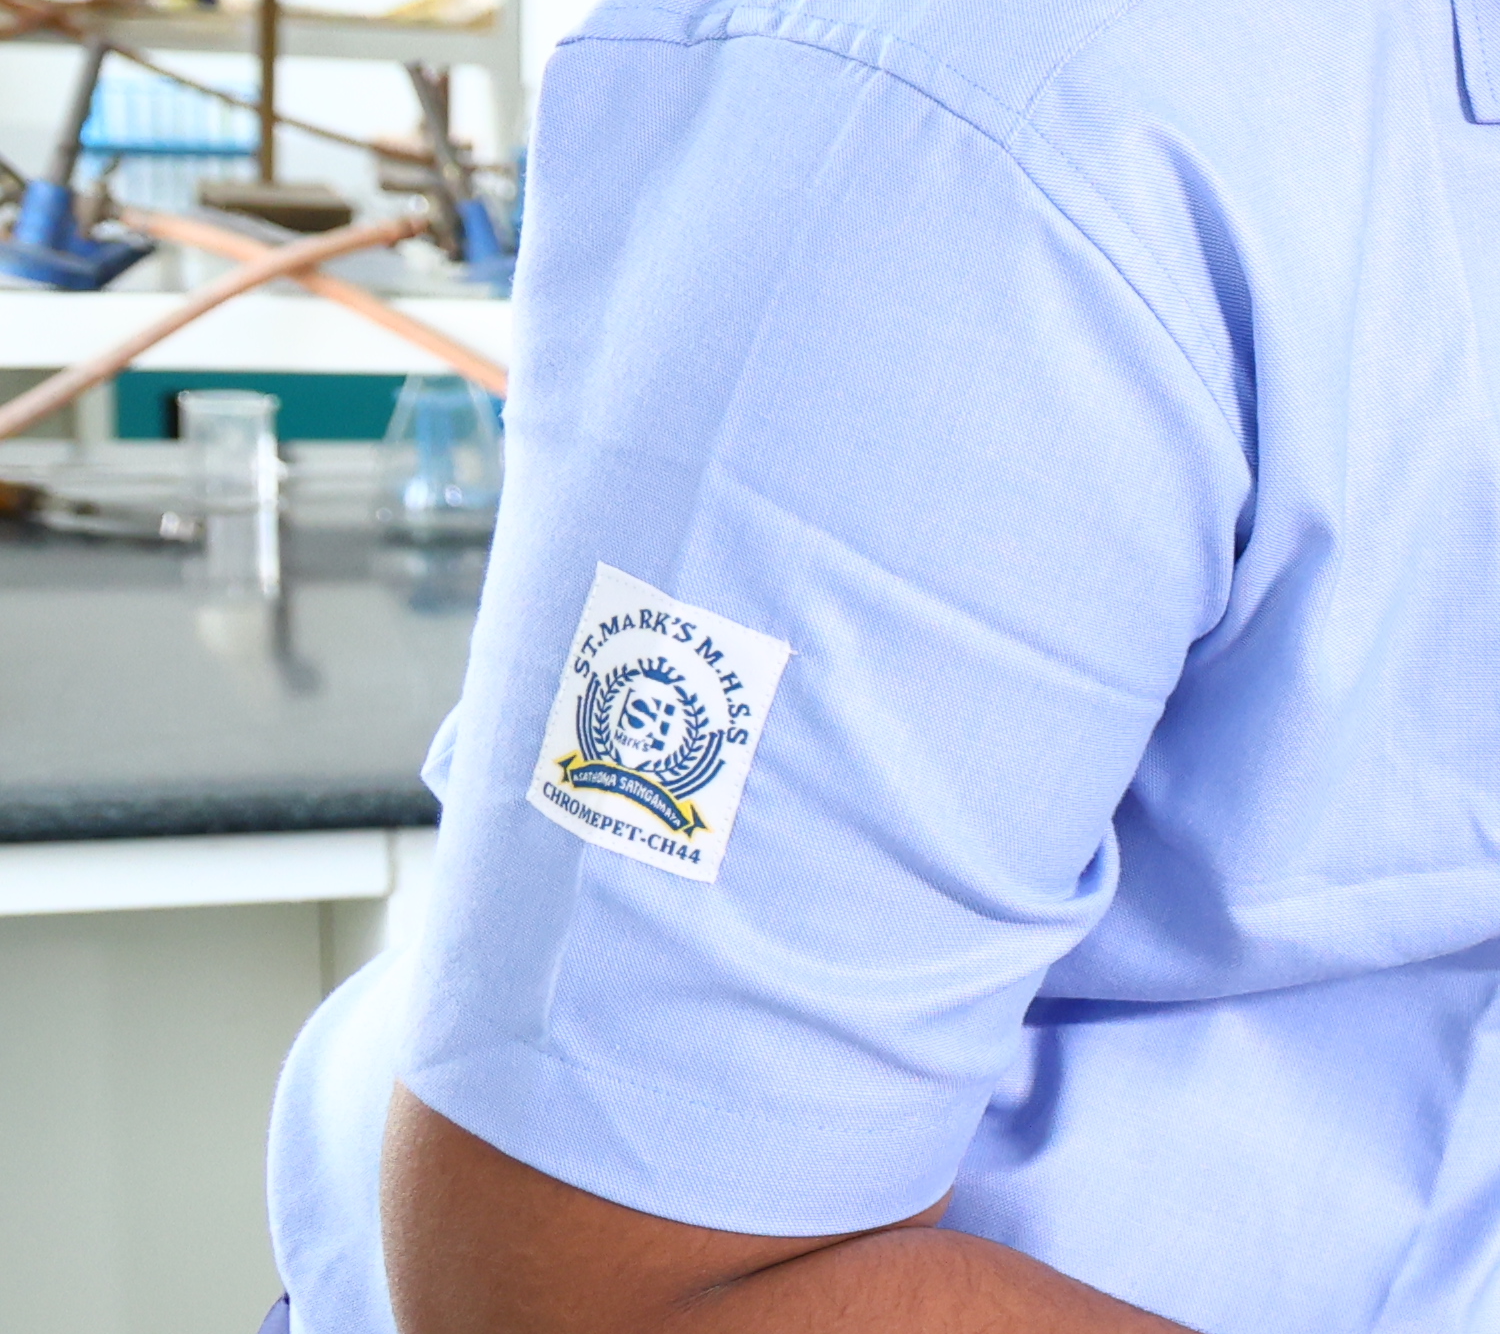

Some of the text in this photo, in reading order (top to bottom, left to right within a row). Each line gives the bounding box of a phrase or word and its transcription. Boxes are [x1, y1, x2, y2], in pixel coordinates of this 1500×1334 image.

[573, 608, 751, 746] ST.MARK'S M.H.S.S
[542, 781, 701, 865] CHROMEPET-CH44
